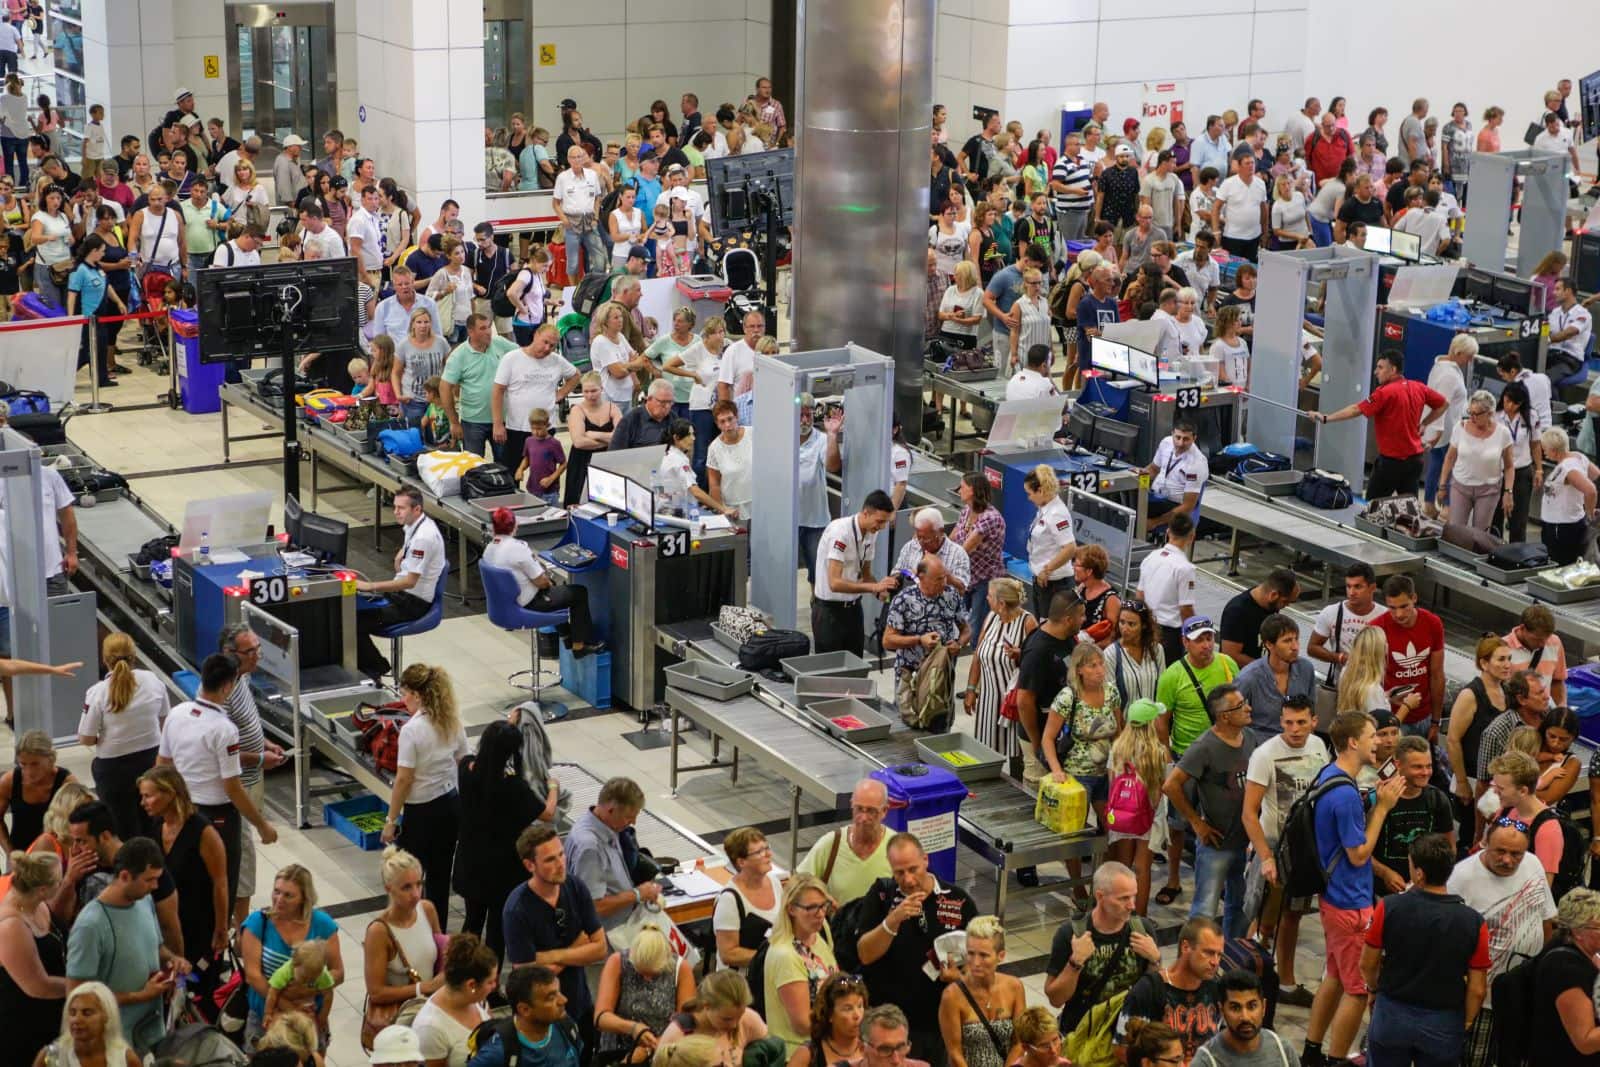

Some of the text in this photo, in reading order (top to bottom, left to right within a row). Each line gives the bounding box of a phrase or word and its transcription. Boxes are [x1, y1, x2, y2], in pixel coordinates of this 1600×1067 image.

[1522, 319, 1540, 337] 34
[1178, 389, 1198, 408] 33
[1074, 472, 1097, 493] 32
[663, 533, 686, 556] 31
[254, 578, 285, 604] 30
[1395, 666, 1428, 679] adidas
